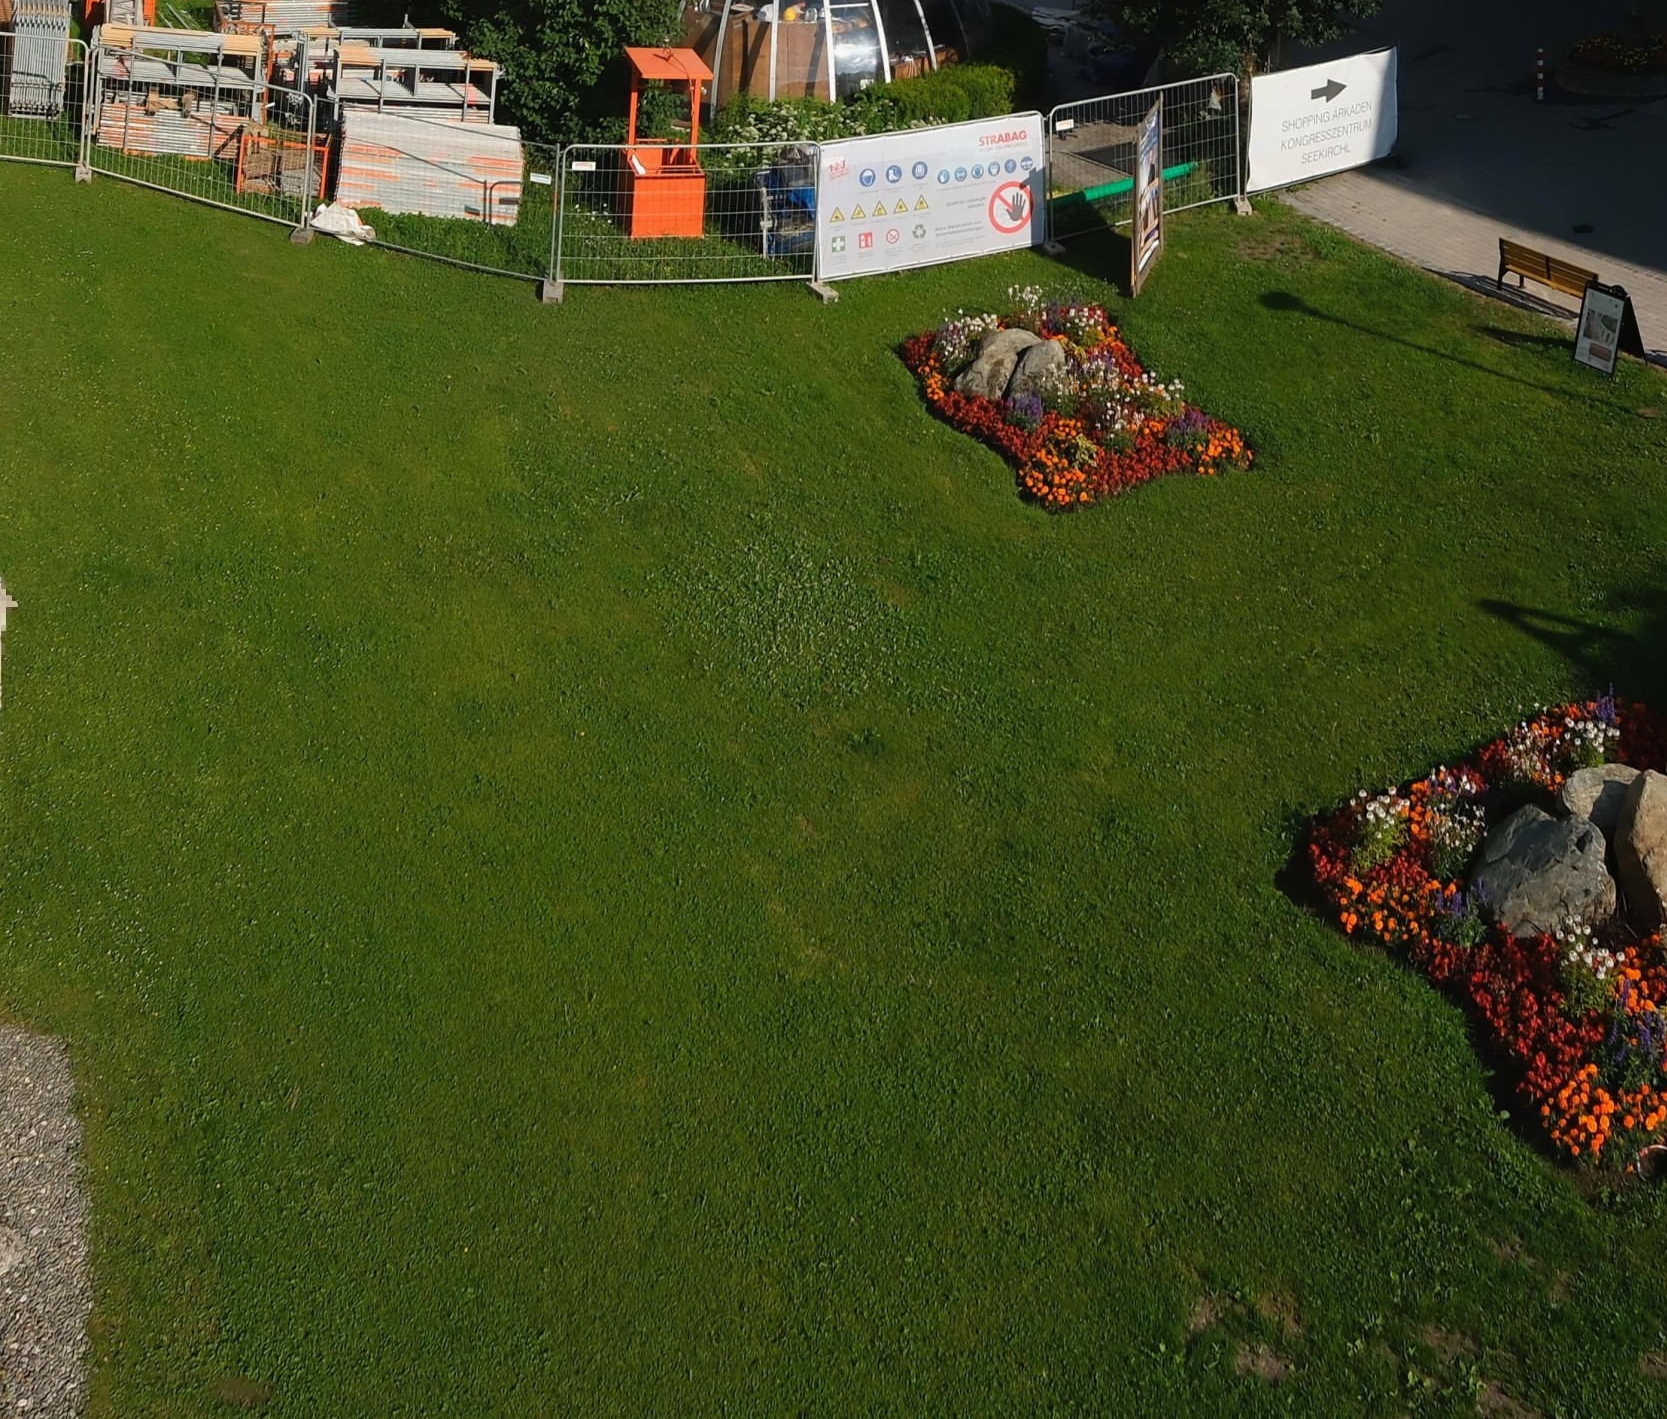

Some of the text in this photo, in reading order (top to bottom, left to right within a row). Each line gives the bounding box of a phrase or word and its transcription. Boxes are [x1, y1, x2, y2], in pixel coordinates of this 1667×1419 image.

[1282, 101, 1372, 132] SHOPPING ARKADEN
[979, 130, 1027, 147] STRABAG
[1281, 118, 1372, 151] KONGRESSZENTRUM
[1301, 142, 1352, 164] SEEKIRCHL
